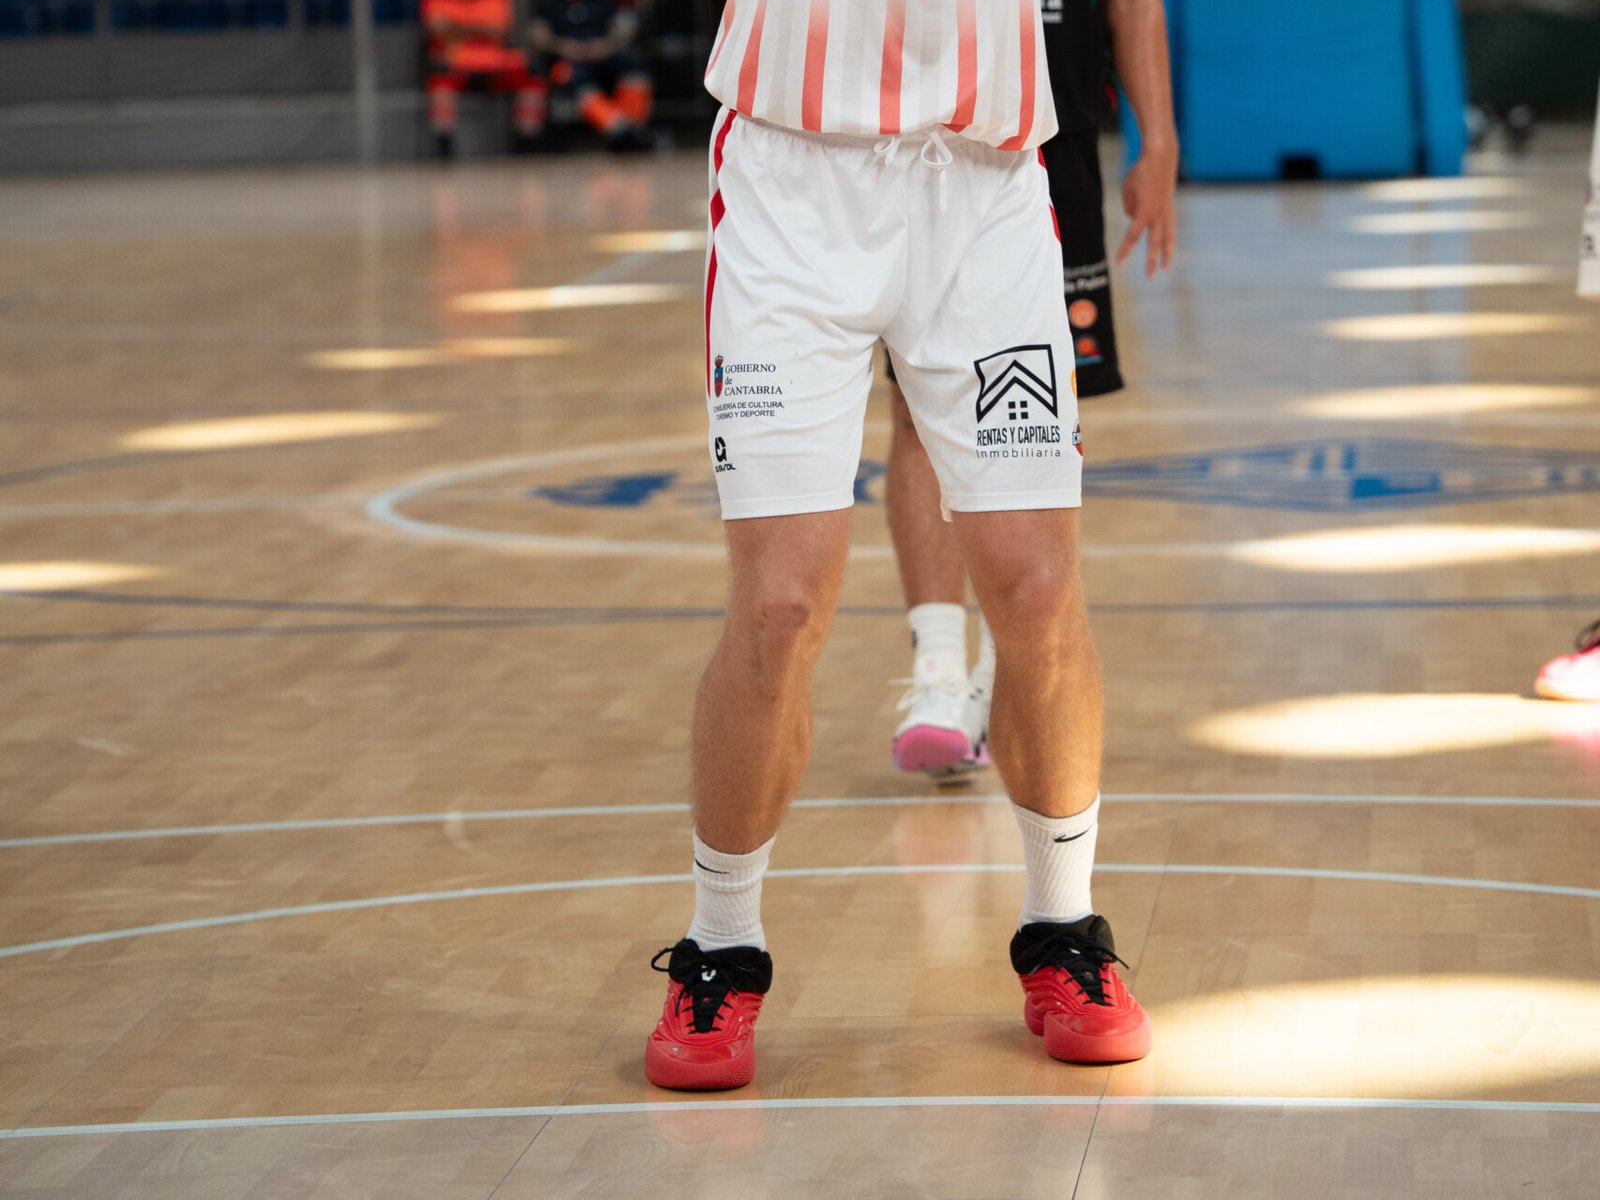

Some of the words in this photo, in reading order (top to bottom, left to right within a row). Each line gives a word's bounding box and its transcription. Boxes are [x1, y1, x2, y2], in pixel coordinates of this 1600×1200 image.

[725, 363, 777, 375] GOBIERNO
[724, 377, 733, 386] de
[724, 385, 783, 397] CANTABRIA
[748, 401, 785, 409] CULTURA,
[740, 410, 775, 418] DEPORTE
[977, 428, 1008, 446] RENTAS
[1009, 427, 1016, 444] Y
[1017, 425, 1060, 444] CAPITALES
